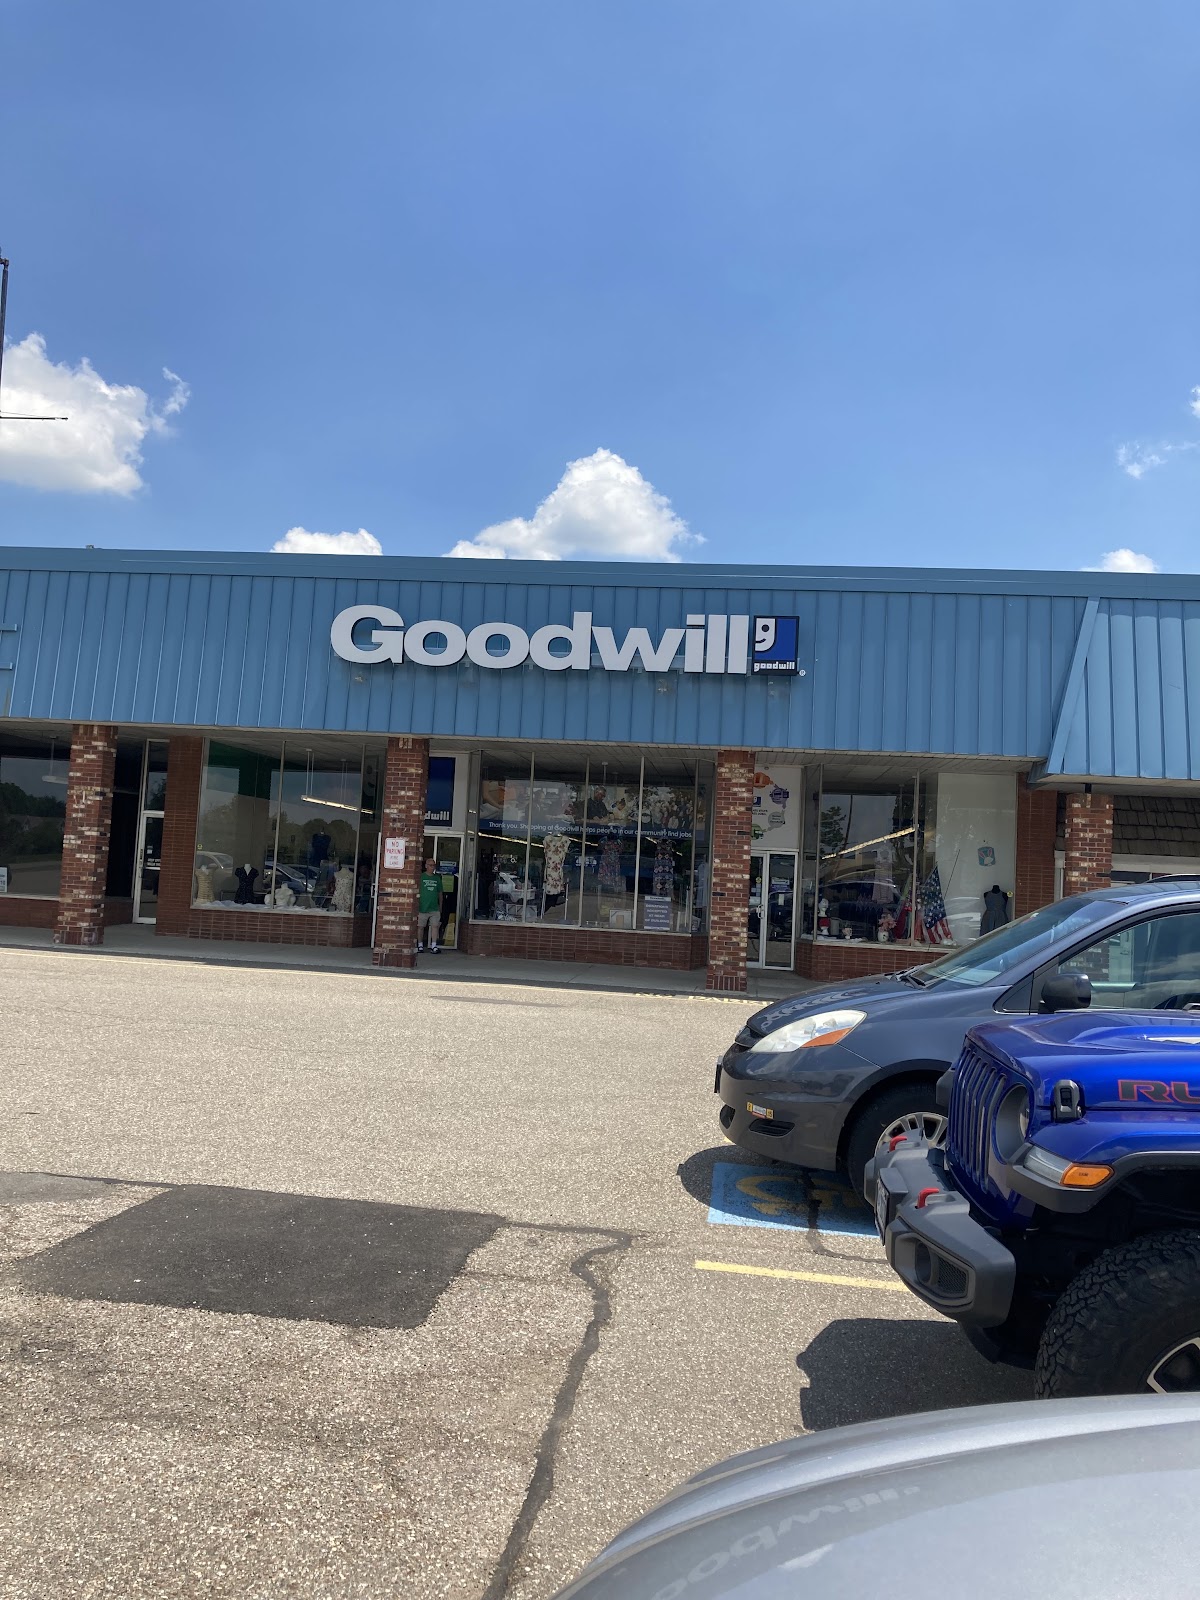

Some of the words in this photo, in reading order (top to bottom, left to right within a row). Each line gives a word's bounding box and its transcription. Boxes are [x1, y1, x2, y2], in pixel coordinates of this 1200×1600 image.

[331, 604, 749, 674] Goodwill
[753, 661, 795, 672] goodwill
[634, 829, 667, 837] cmmunity
